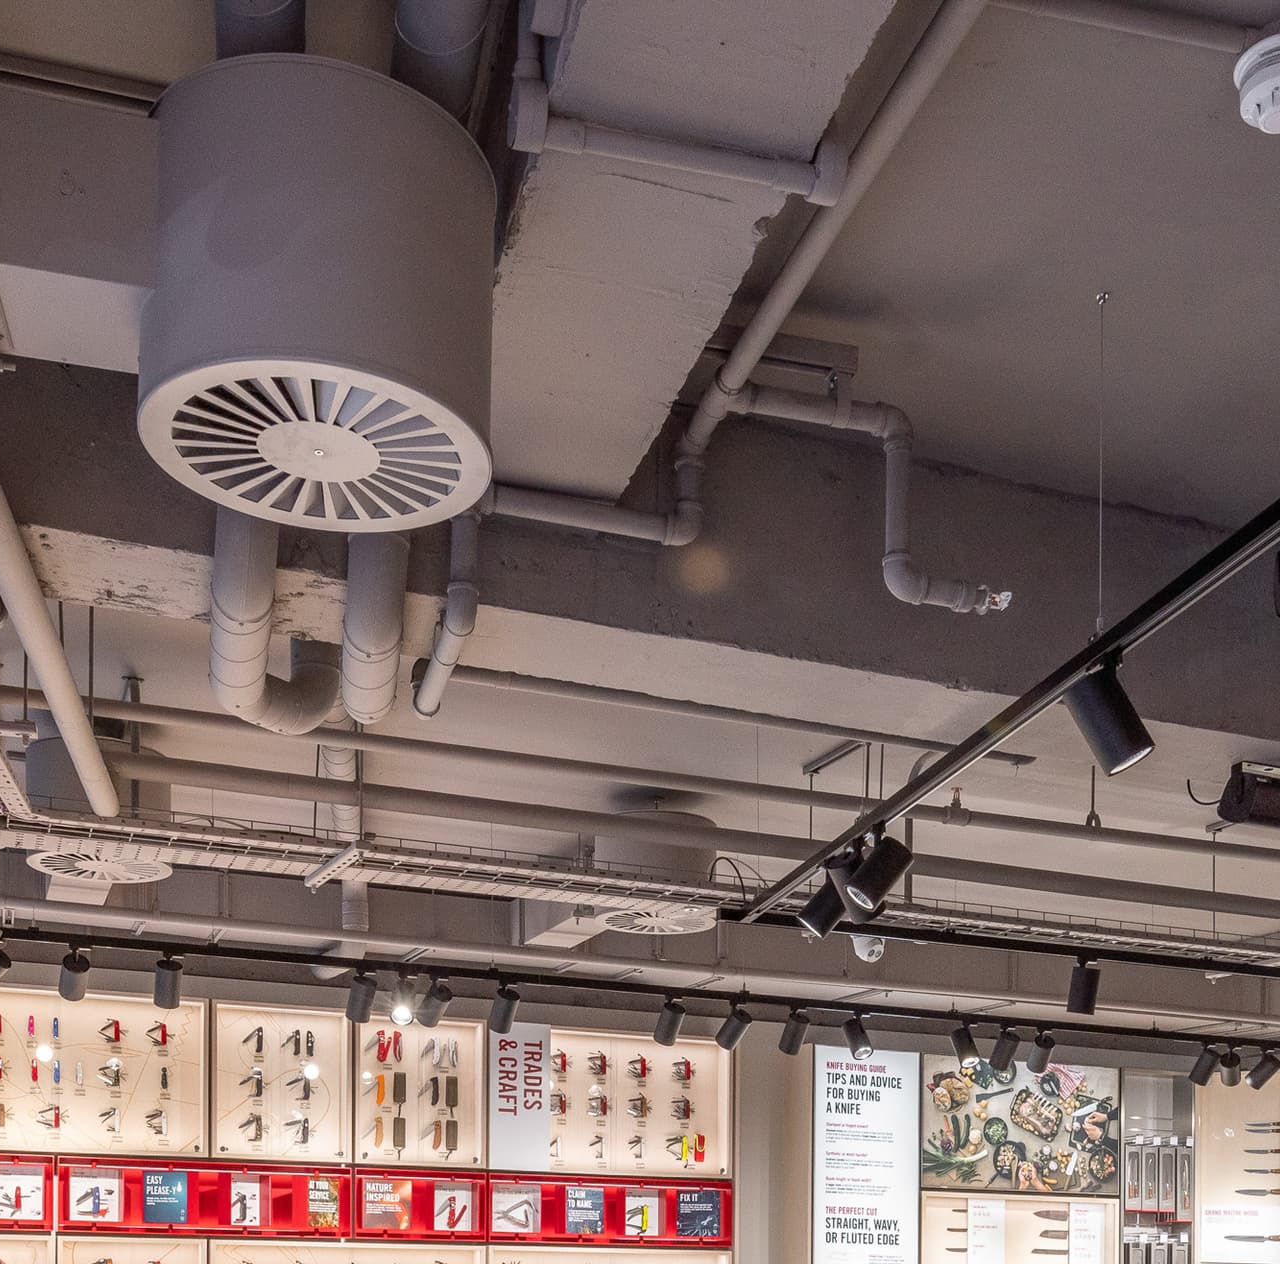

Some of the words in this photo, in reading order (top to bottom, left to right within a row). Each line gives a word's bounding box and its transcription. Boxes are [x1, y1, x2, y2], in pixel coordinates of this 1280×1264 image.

[498, 1038, 518, 1051] &
[826, 1061, 843, 1070] KNIFE
[845, 1062, 867, 1072] BUYING
[869, 1064, 887, 1074] GUIDE
[523, 1040, 543, 1110] TRADES
[826, 1072, 847, 1085] TIPS
[849, 1074, 867, 1087] AND
[870, 1075, 903, 1090] ADVICE
[498, 1057, 518, 1116] CRAFT
[826, 1087, 844, 1099] FOR
[847, 1088, 881, 1102] BUYING
[826, 1101, 832, 1113] A
[835, 1102, 861, 1115] KNIFE
[146, 1175, 163, 1184] EASY
[146, 1185, 177, 1195] PLEASE-Y
[366, 1182, 393, 1192] NATURE
[366, 1192, 400, 1202] INSPIRED
[567, 1199, 576, 1208] TO
[680, 1193, 691, 1202] FIX
[691, 1193, 698, 1202] IT
[825, 1205, 836, 1214] THE
[838, 1206, 864, 1215] PERFECT
[866, 1207, 878, 1216] CUT
[825, 1217, 871, 1231] STRAIGHT,
[873, 1218, 900, 1232] WAVY,
[825, 1231, 838, 1243] OR
[841, 1232, 874, 1245] FLUTED
[877, 1233, 900, 1246] EDGE
